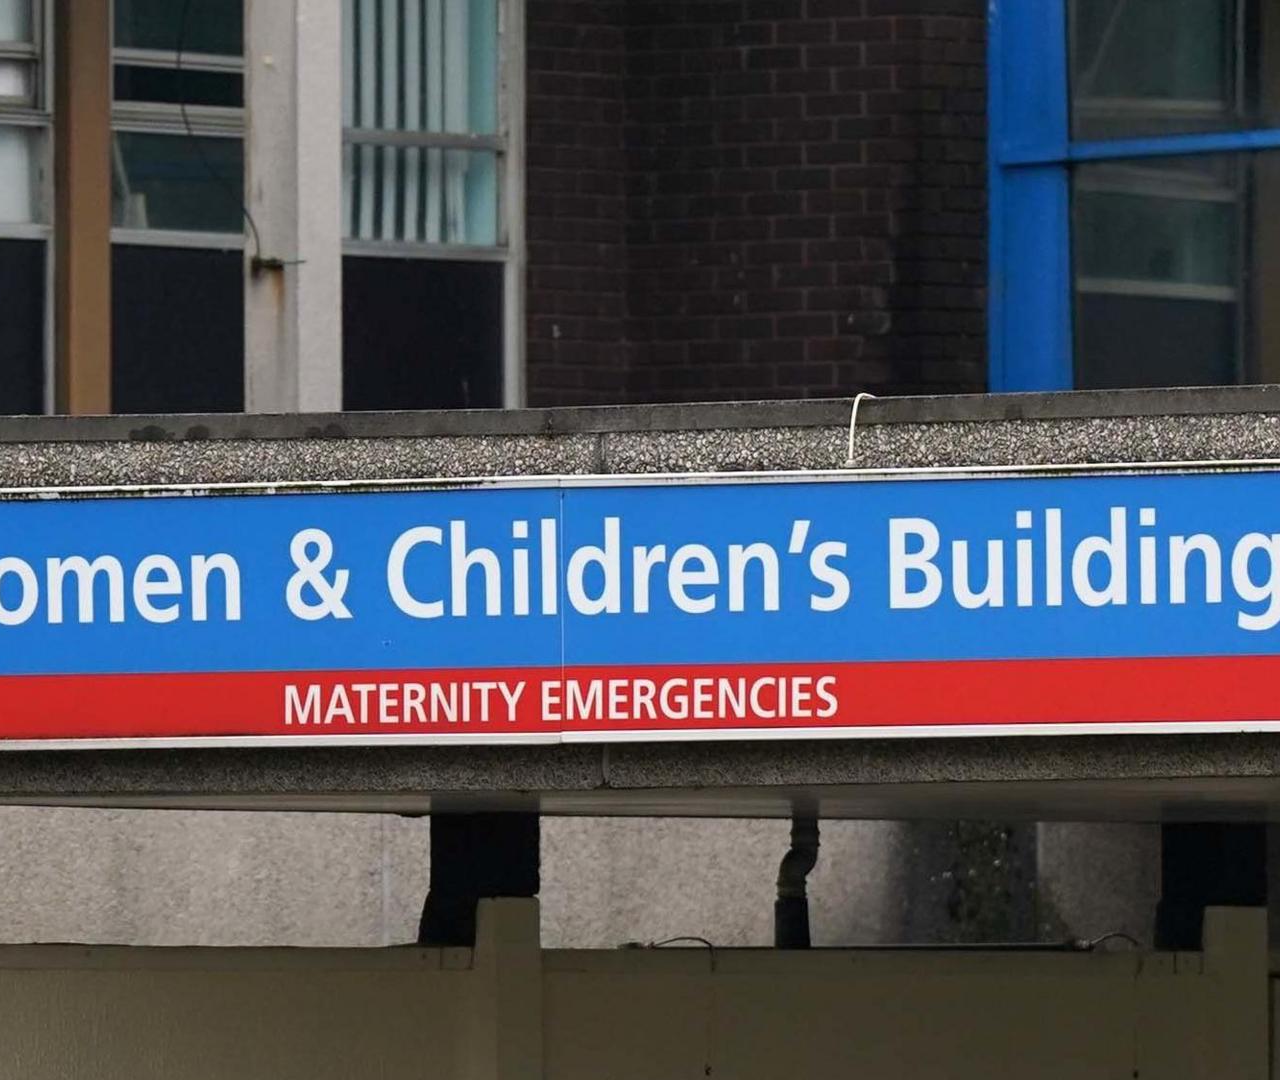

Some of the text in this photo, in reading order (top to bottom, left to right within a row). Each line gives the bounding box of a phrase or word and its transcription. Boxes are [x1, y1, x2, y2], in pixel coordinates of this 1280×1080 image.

[283, 527, 353, 621] &
[386, 516, 850, 620] Children's
[283, 674, 839, 725] MATERNITY EMERGENCIES
